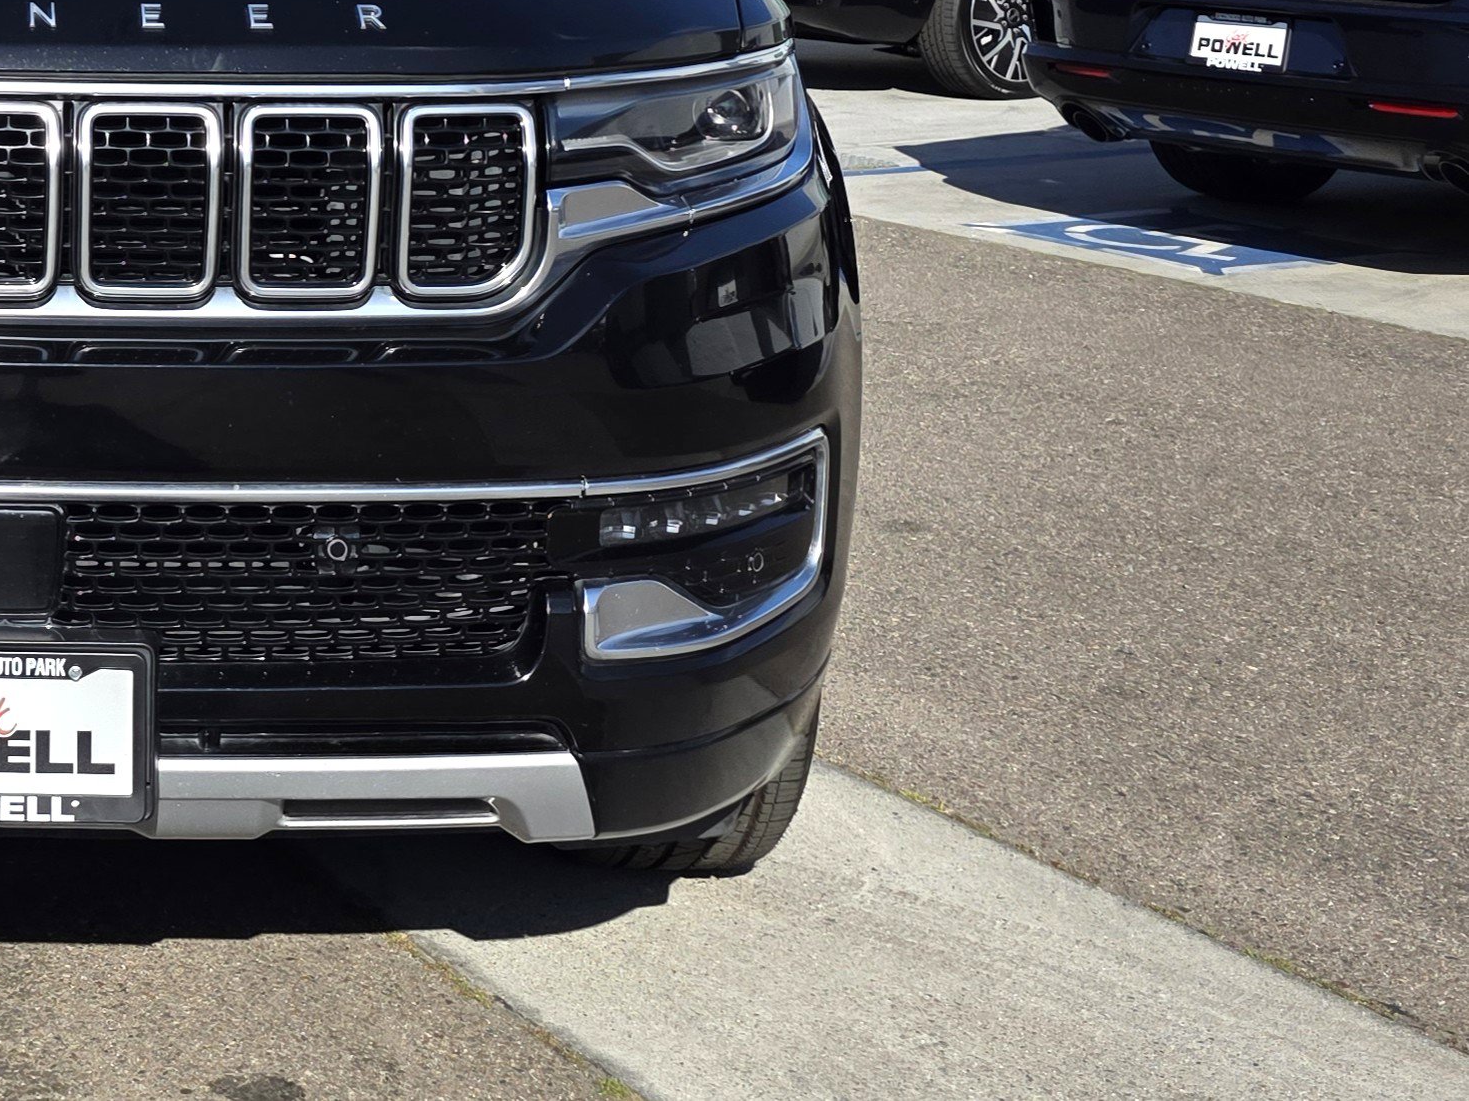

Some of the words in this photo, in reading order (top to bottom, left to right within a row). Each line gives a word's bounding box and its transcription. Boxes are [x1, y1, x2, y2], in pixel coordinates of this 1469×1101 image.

[1197, 36, 1279, 59] POWELL
[1205, 57, 1263, 73] POWELL
[25, 658, 67, 678] PARK
